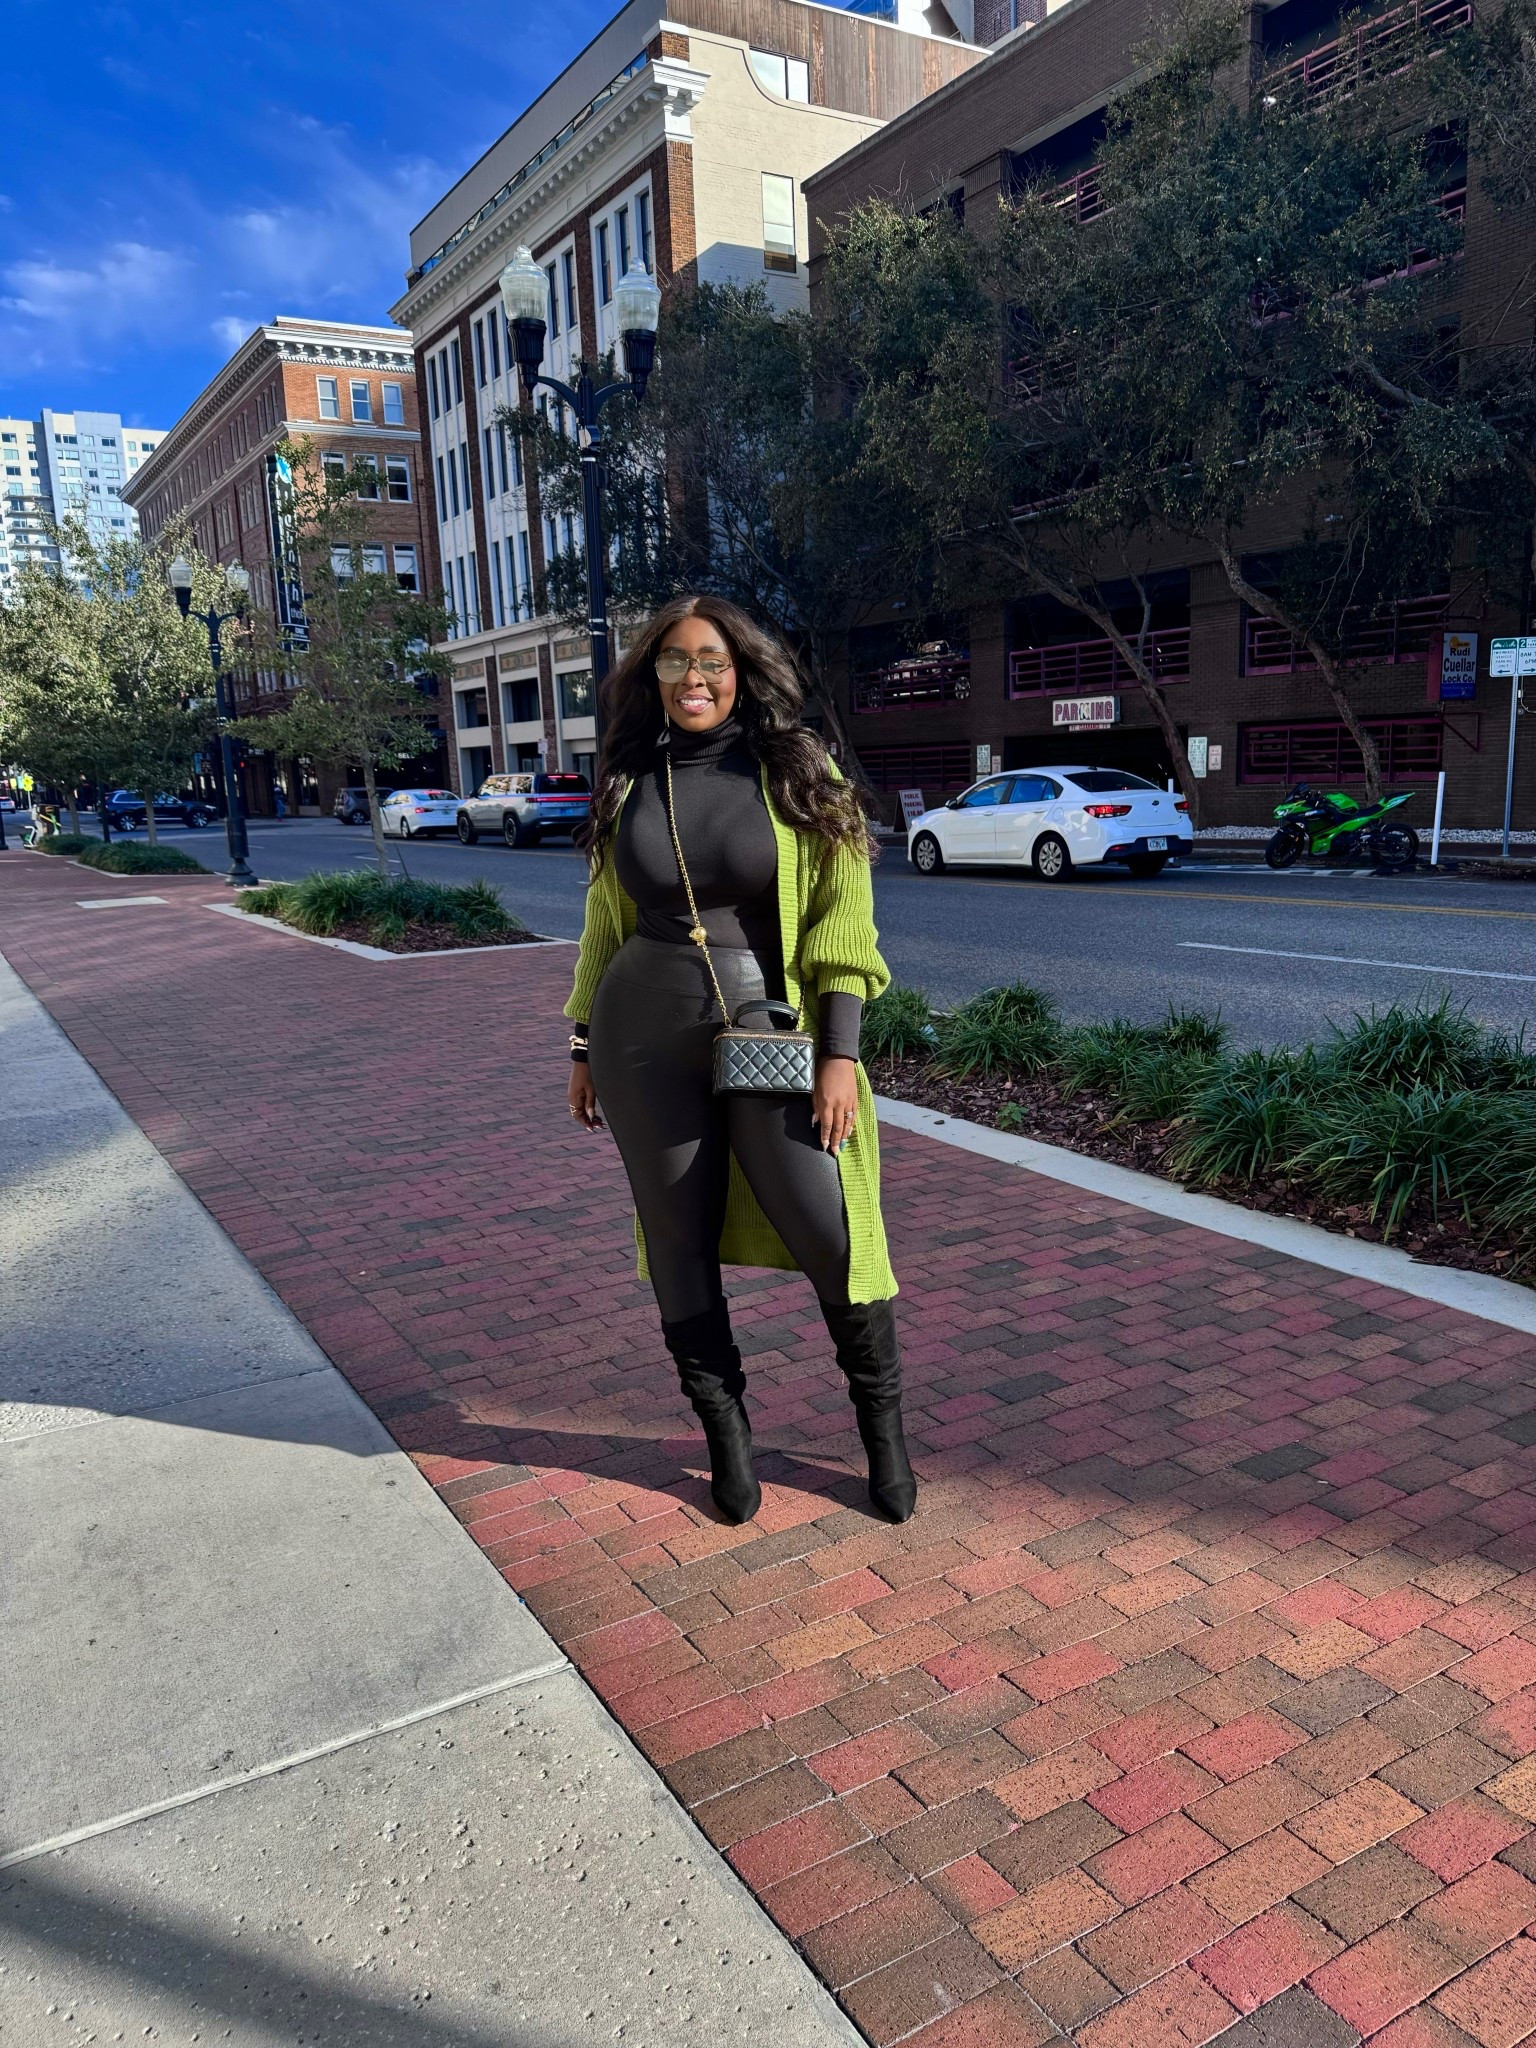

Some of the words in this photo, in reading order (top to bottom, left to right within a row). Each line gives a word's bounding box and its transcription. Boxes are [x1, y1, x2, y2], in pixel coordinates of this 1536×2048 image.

[1520, 639, 1526, 648] 2
[1450, 647, 1471, 656] Rudi
[1443, 657, 1475, 672] Cuellar
[1443, 673, 1461, 683] Lock
[1462, 673, 1475, 683] Co.
[1055, 701, 1112, 721] PARKING
